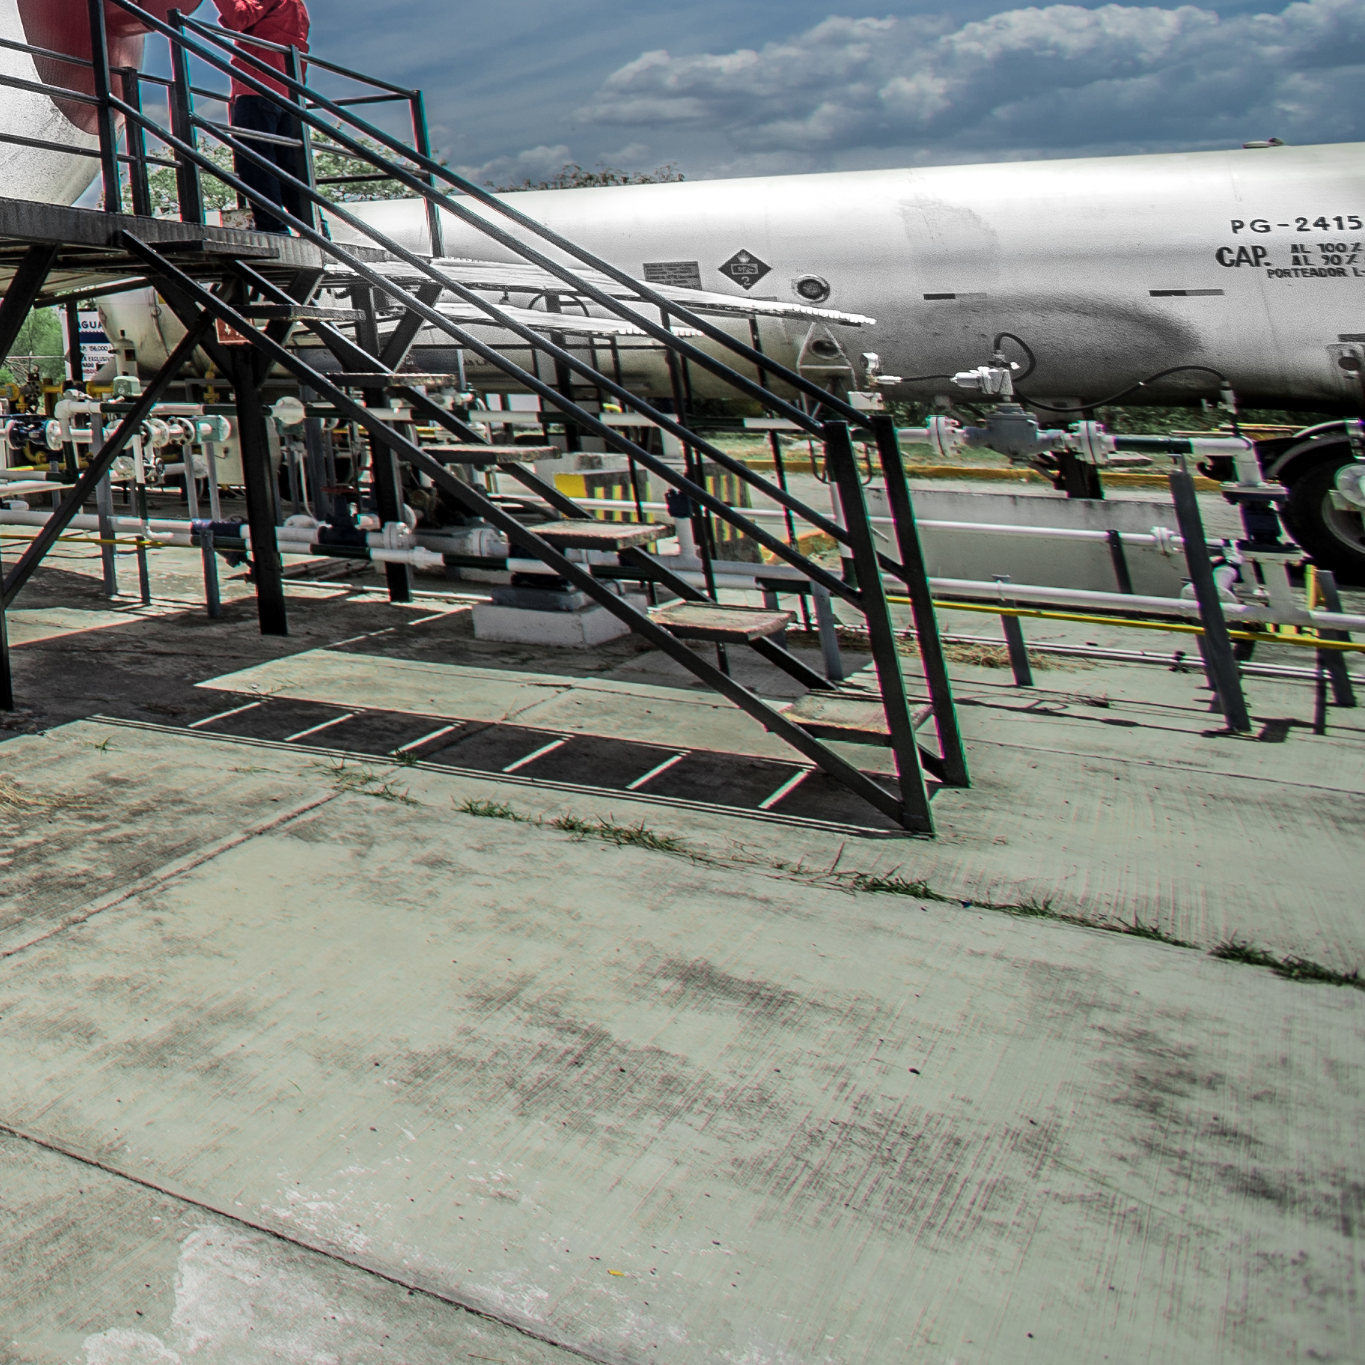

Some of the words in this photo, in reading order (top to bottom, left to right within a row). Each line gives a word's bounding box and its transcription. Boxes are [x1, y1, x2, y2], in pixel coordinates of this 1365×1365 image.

[1215, 245, 1272, 268] CAP.
[1290, 244, 1311, 254] AL
[1291, 255, 1315, 266] AL
[1266, 267, 1349, 279] PORTEADOR
[740, 276, 752, 286] 2
